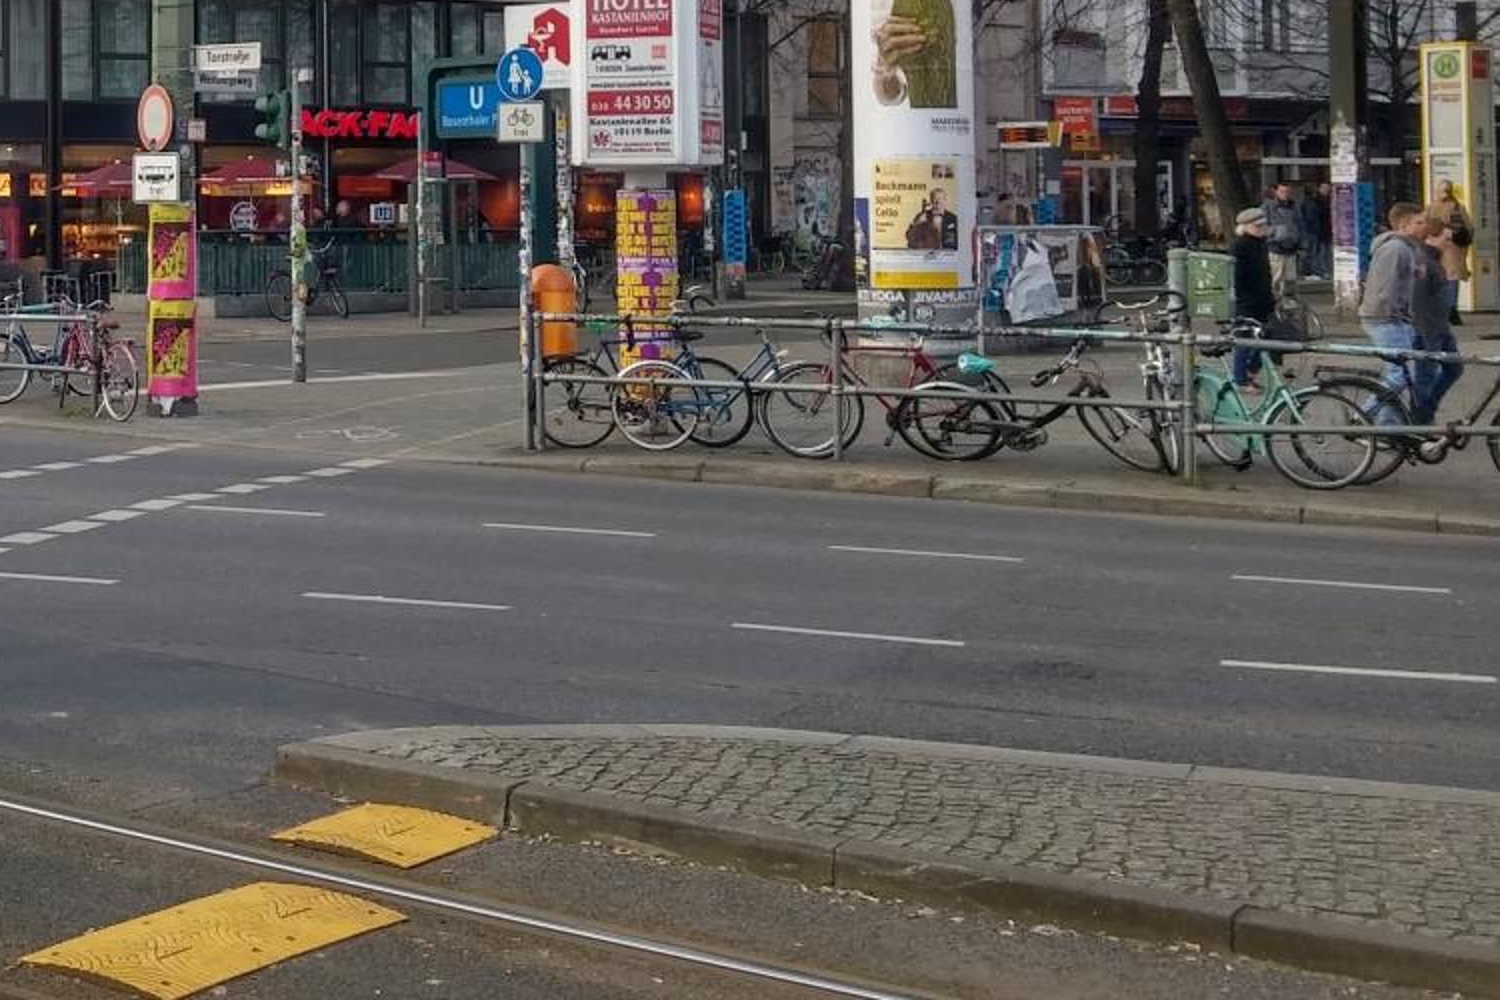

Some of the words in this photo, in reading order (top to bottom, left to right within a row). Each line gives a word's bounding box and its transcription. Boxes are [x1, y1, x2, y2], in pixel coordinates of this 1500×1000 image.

[591, 9, 669, 24] KASTANIENHOF
[206, 49, 250, 65] Torstraße
[469, 85, 484, 110] U
[643, 127, 672, 136] Berlin
[873, 290, 906, 302] YOGA
